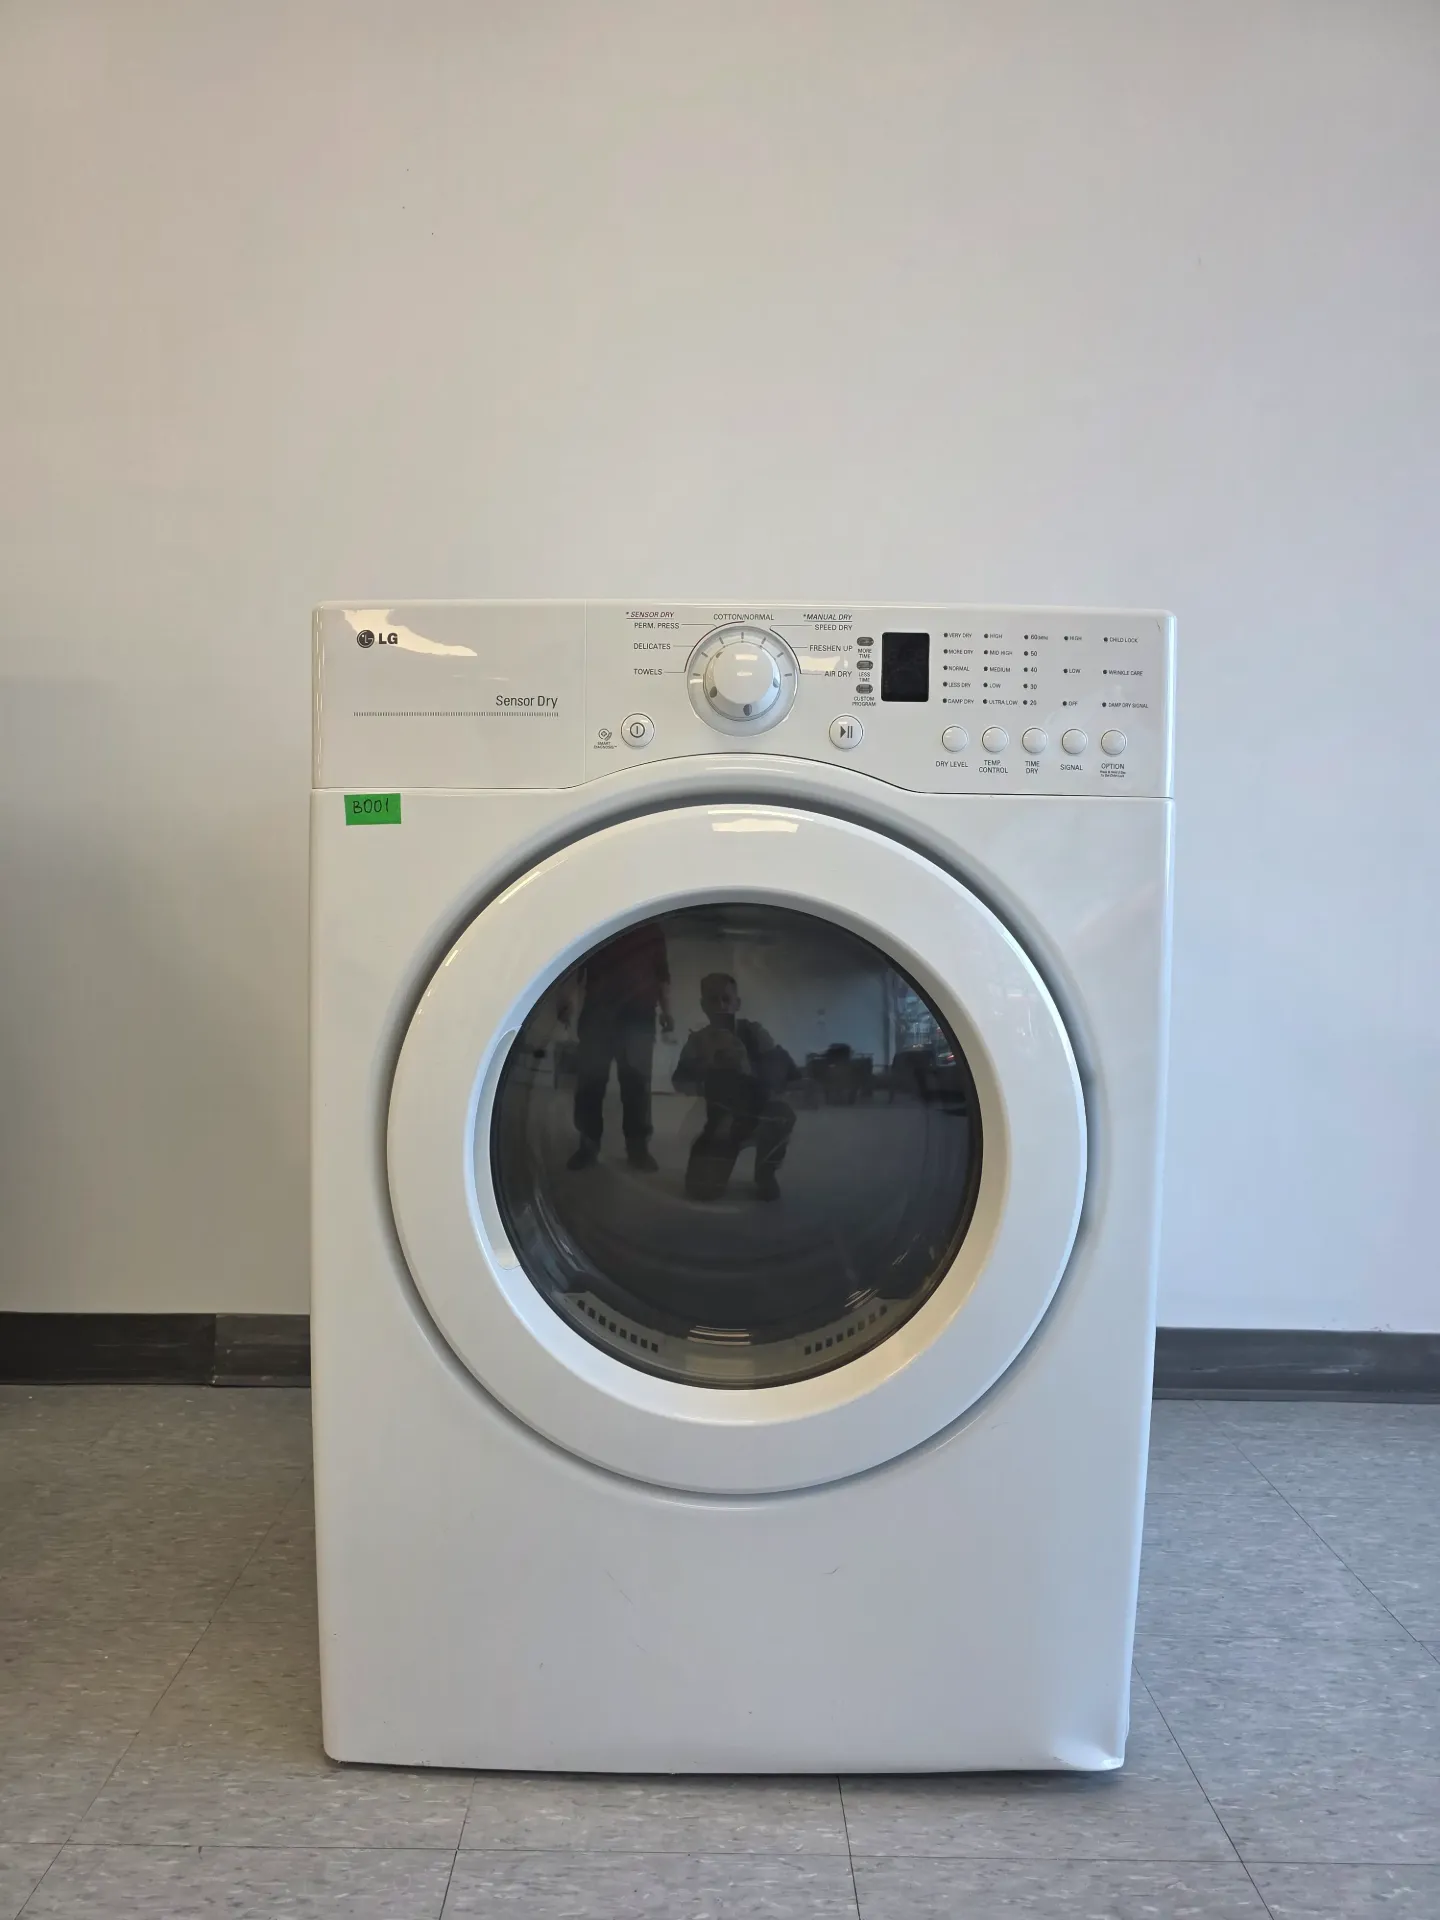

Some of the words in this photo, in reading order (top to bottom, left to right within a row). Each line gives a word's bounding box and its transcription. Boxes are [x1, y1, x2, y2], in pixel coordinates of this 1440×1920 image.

[378, 632, 398, 644] LG
[496, 696, 535, 706] Sensor
[538, 696, 558, 709] Dry
[353, 798, 388, 814] B001
